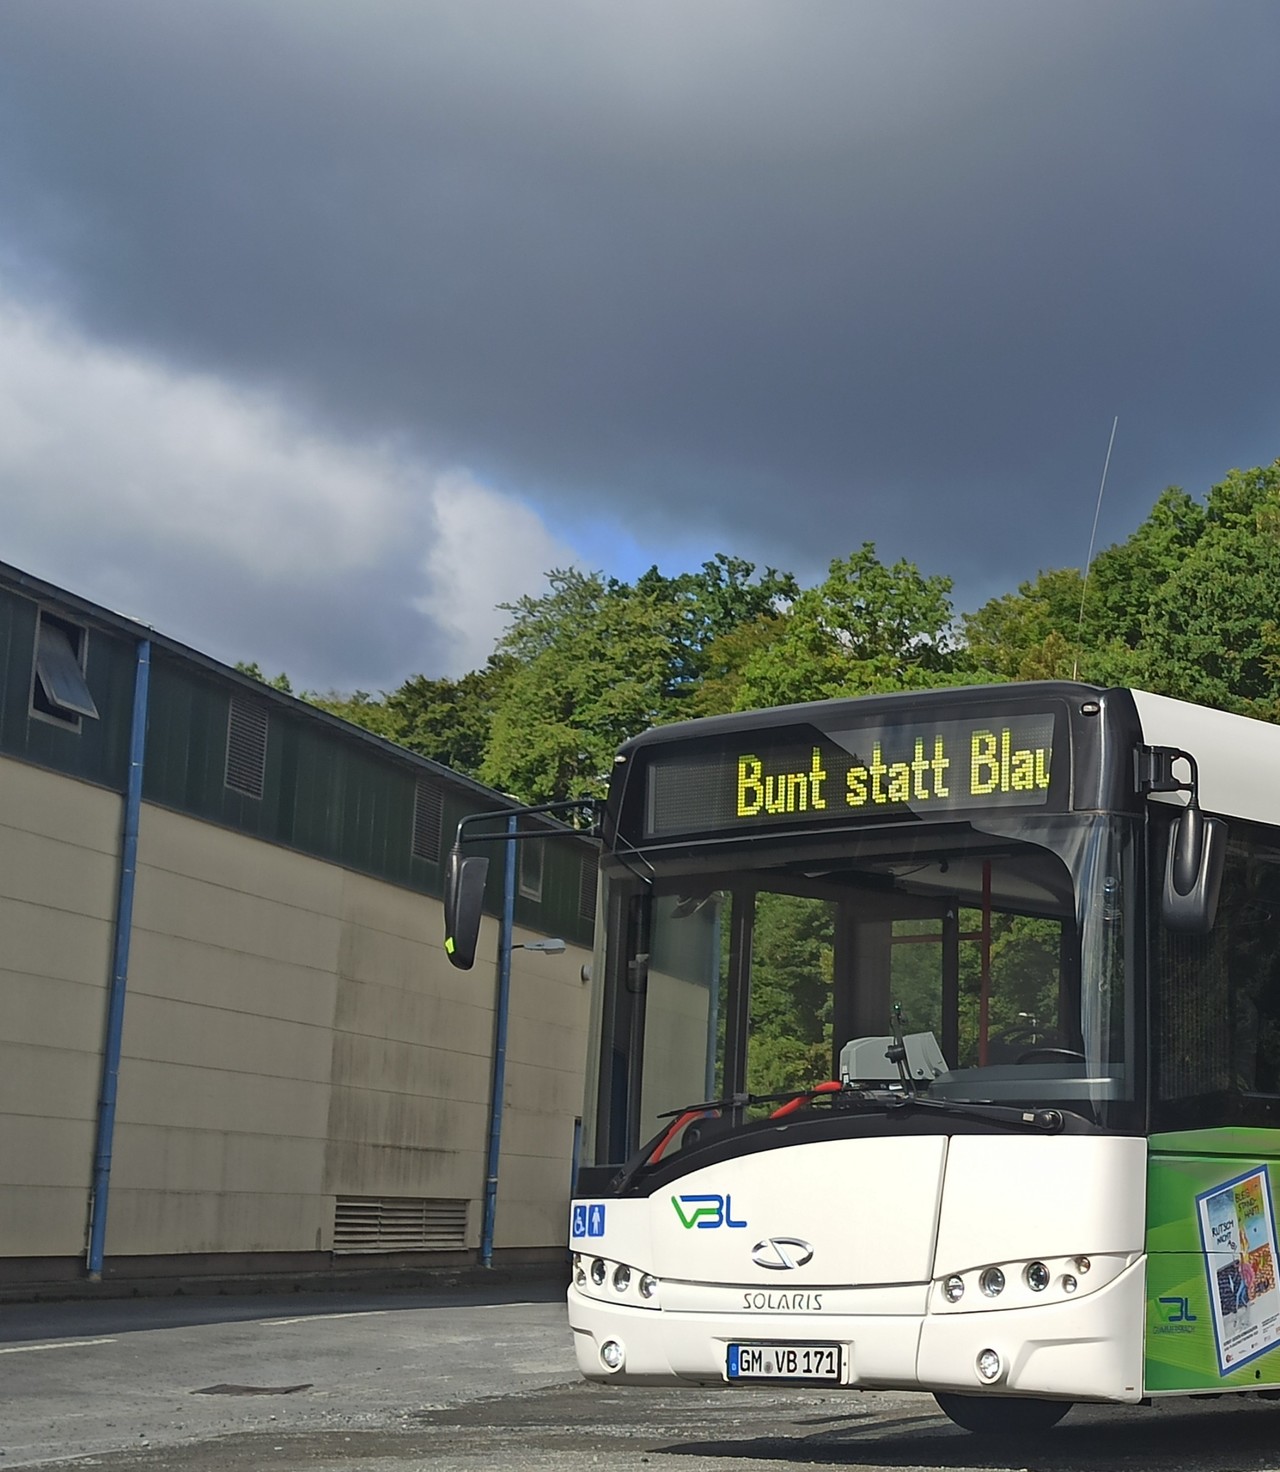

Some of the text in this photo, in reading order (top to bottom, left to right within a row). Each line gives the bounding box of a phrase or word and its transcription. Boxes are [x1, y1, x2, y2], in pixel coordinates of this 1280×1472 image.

[738, 727, 1051, 816] Bunt statt Blau
[671, 1194, 747, 1229] VBL
[743, 1293, 822, 1310] SOLARIS
[740, 1350, 762, 1372] GM
[775, 1351, 797, 1373] VB
[802, 1351, 836, 1373] 171
